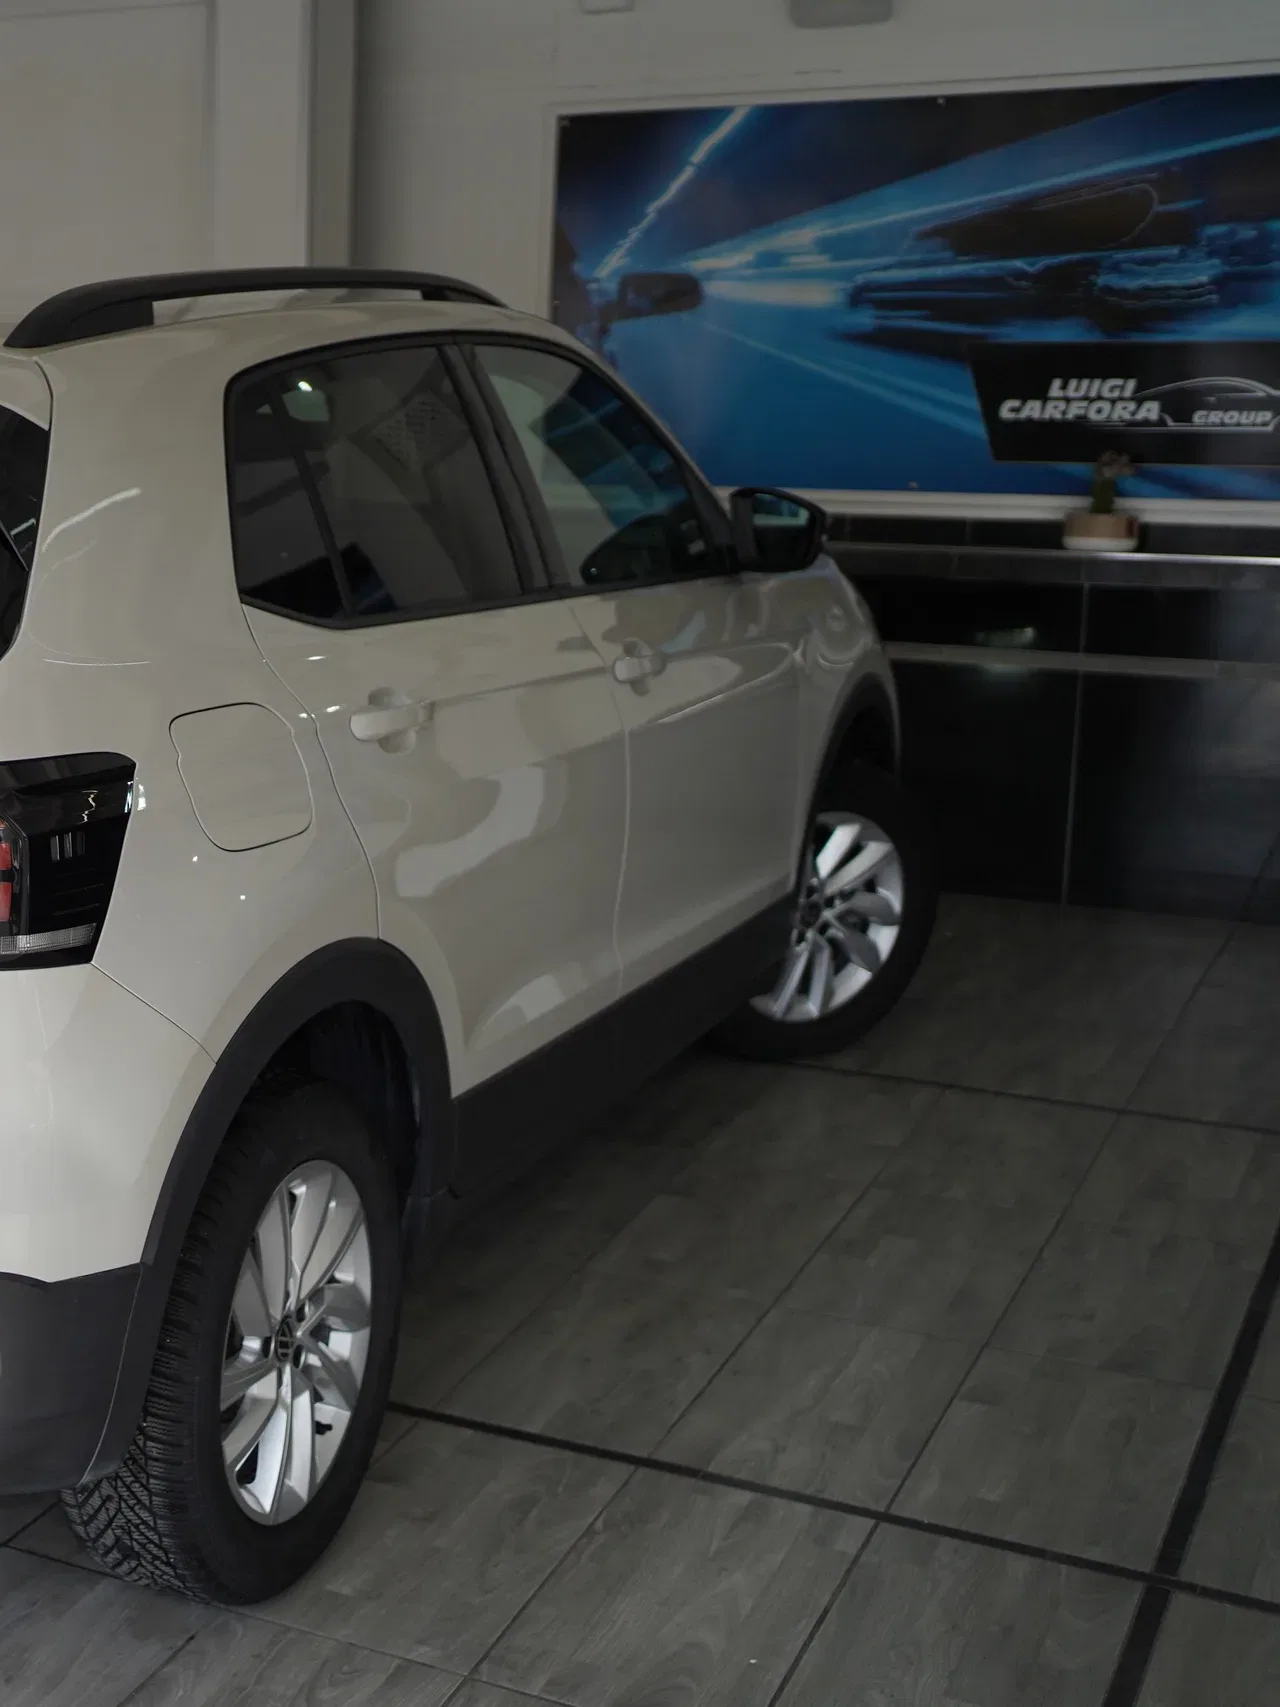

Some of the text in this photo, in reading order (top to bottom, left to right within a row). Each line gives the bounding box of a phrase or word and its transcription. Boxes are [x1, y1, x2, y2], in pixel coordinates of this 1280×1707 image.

[1047, 378, 1137, 399] LUIGI
[999, 398, 1161, 422] CARFORA
[1191, 409, 1273, 426] GROUP
